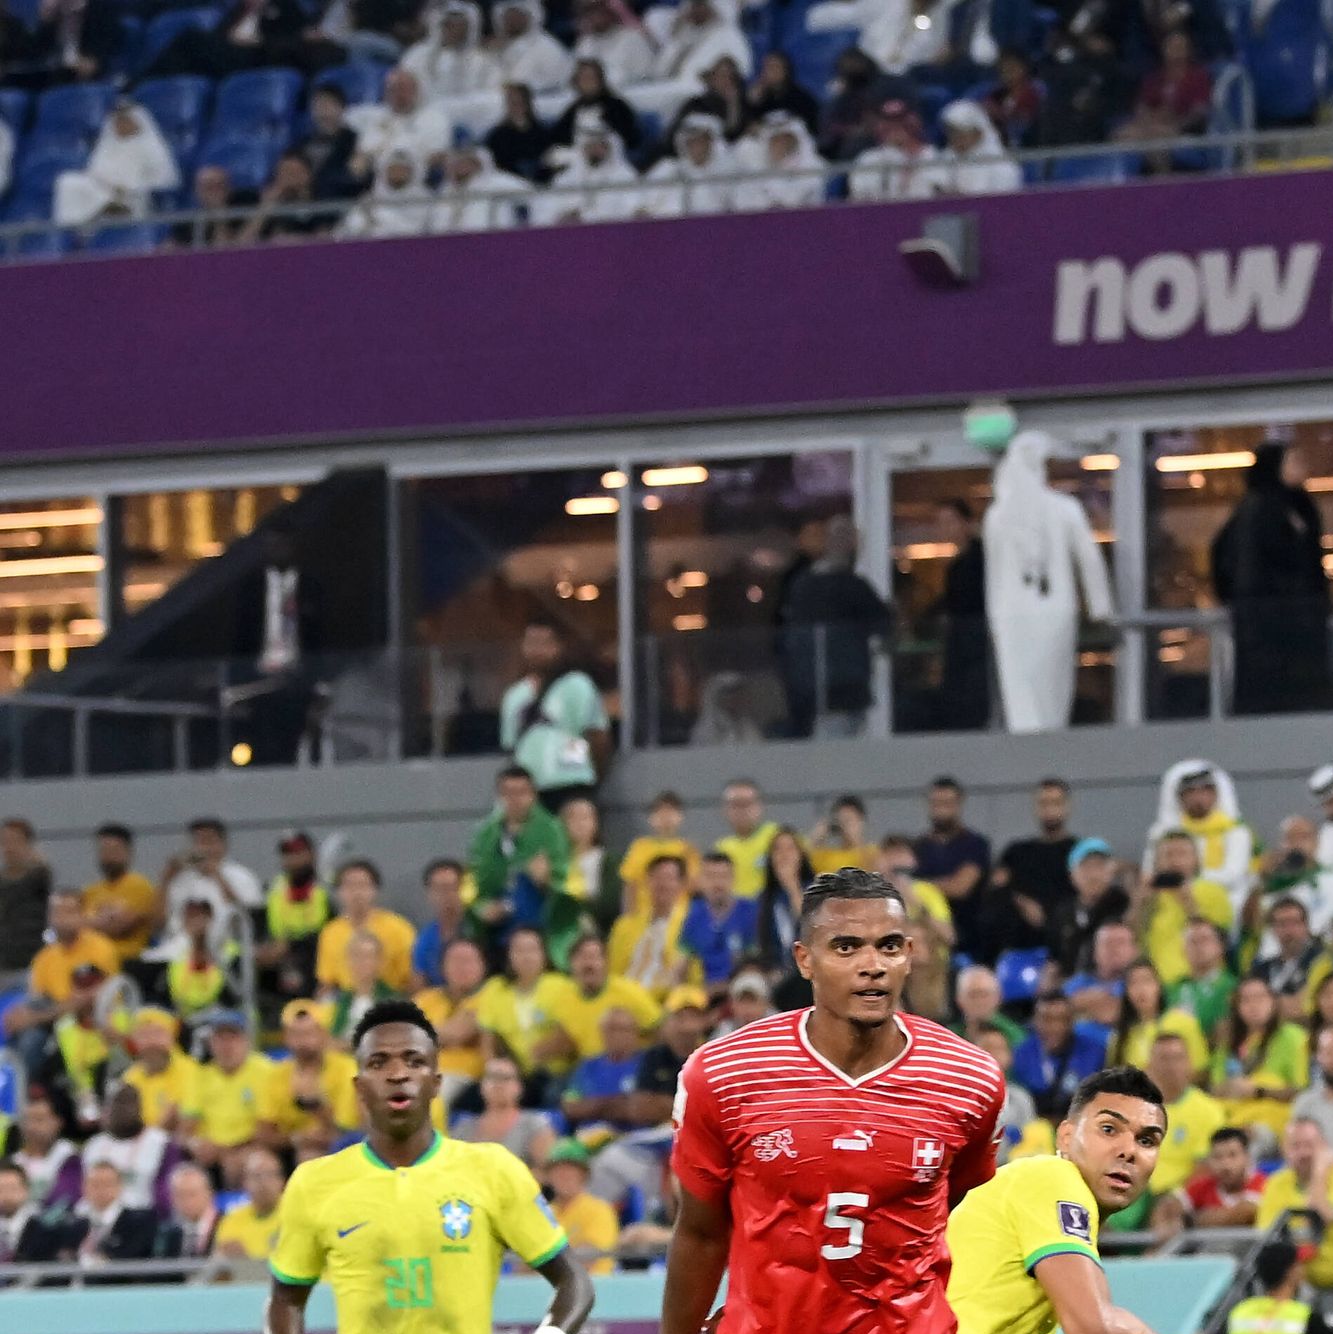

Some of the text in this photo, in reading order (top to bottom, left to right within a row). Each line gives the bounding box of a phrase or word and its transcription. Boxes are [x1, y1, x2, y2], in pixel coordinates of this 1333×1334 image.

[1052, 243, 1322, 346] now
[821, 1192, 870, 1260] 5
[383, 1256, 433, 1309] 20
